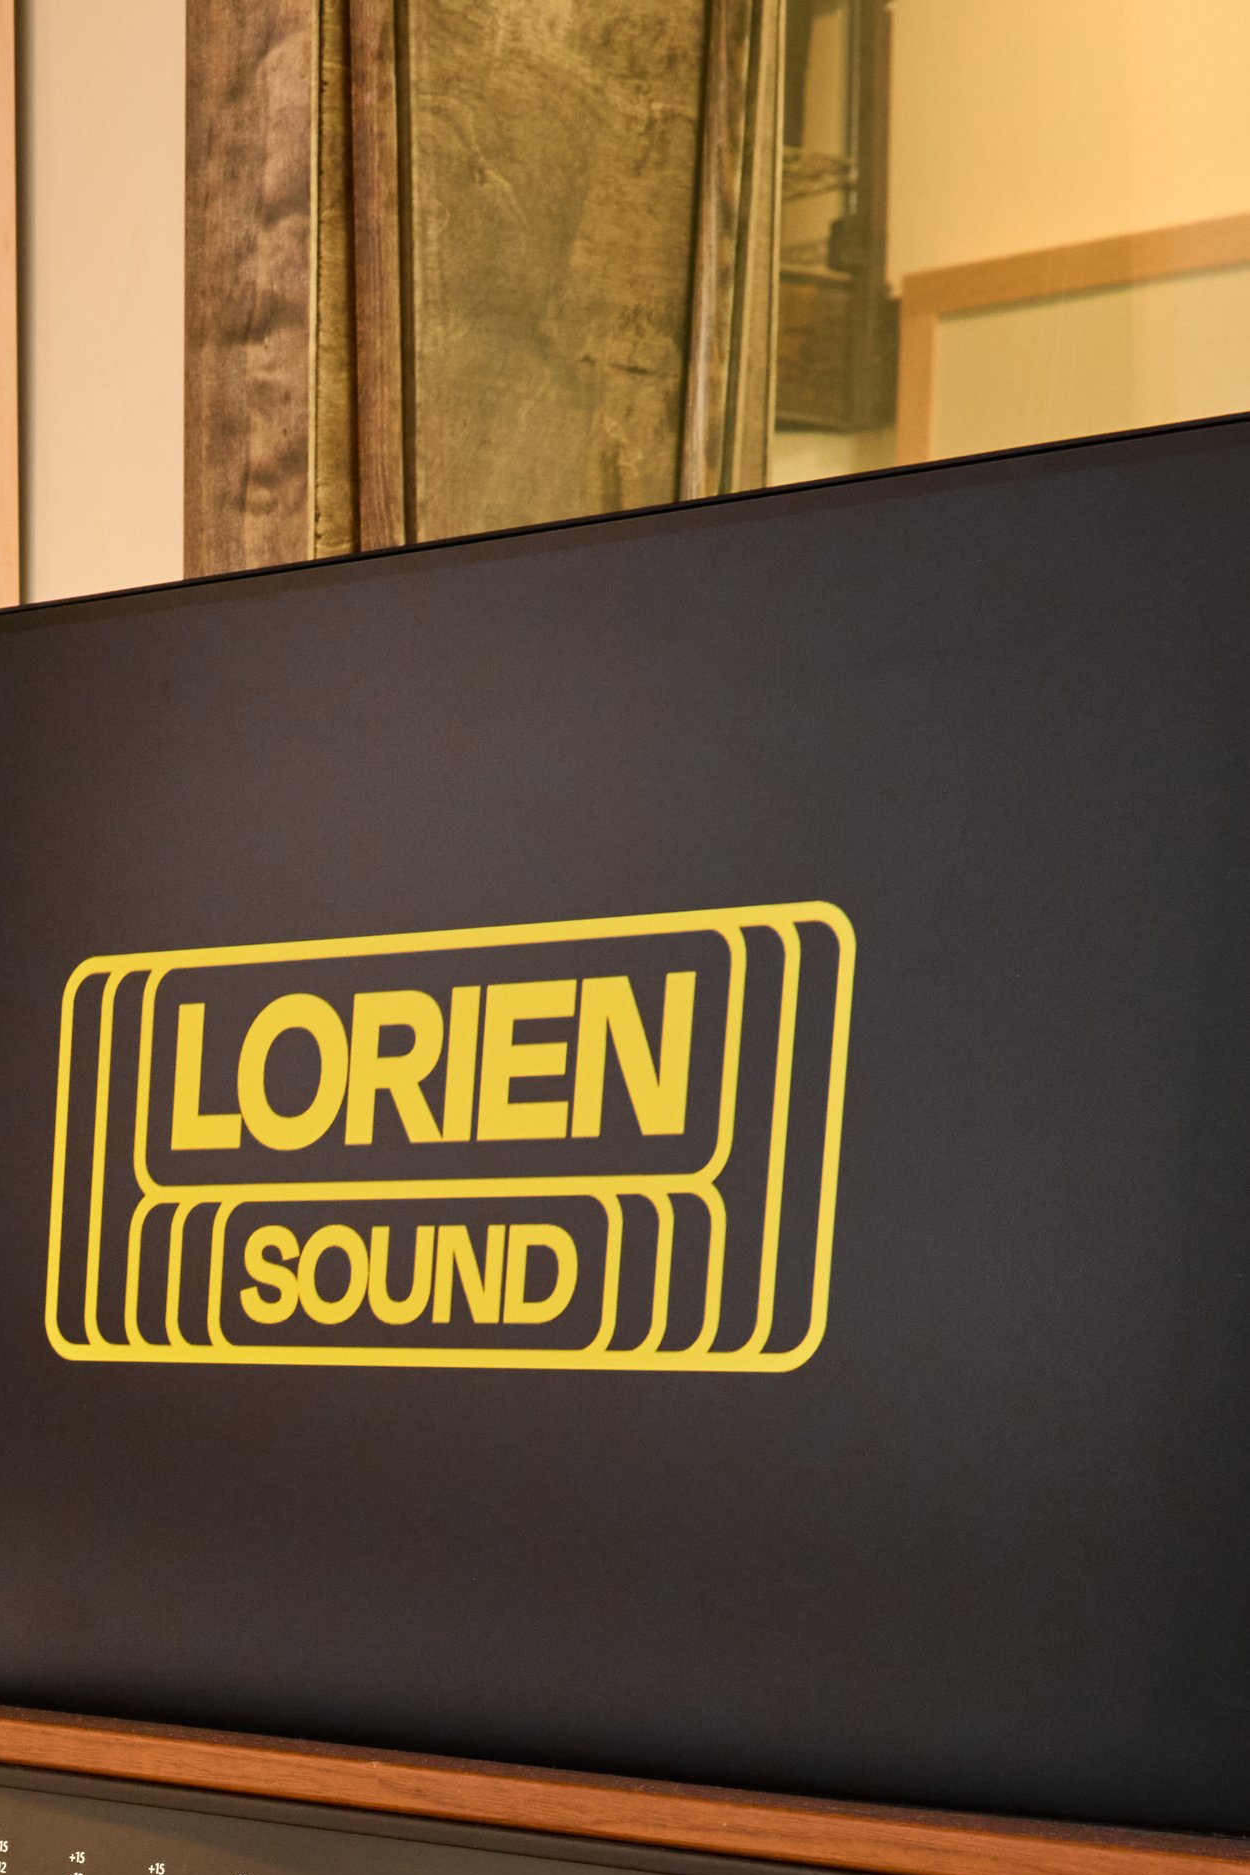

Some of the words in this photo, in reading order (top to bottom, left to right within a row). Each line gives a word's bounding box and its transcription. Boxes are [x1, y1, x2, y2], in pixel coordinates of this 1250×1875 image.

[171, 971, 696, 1151] LORIEN
[240, 1223, 578, 1326] SOUND
[147, 1862, 166, 1875] +15
